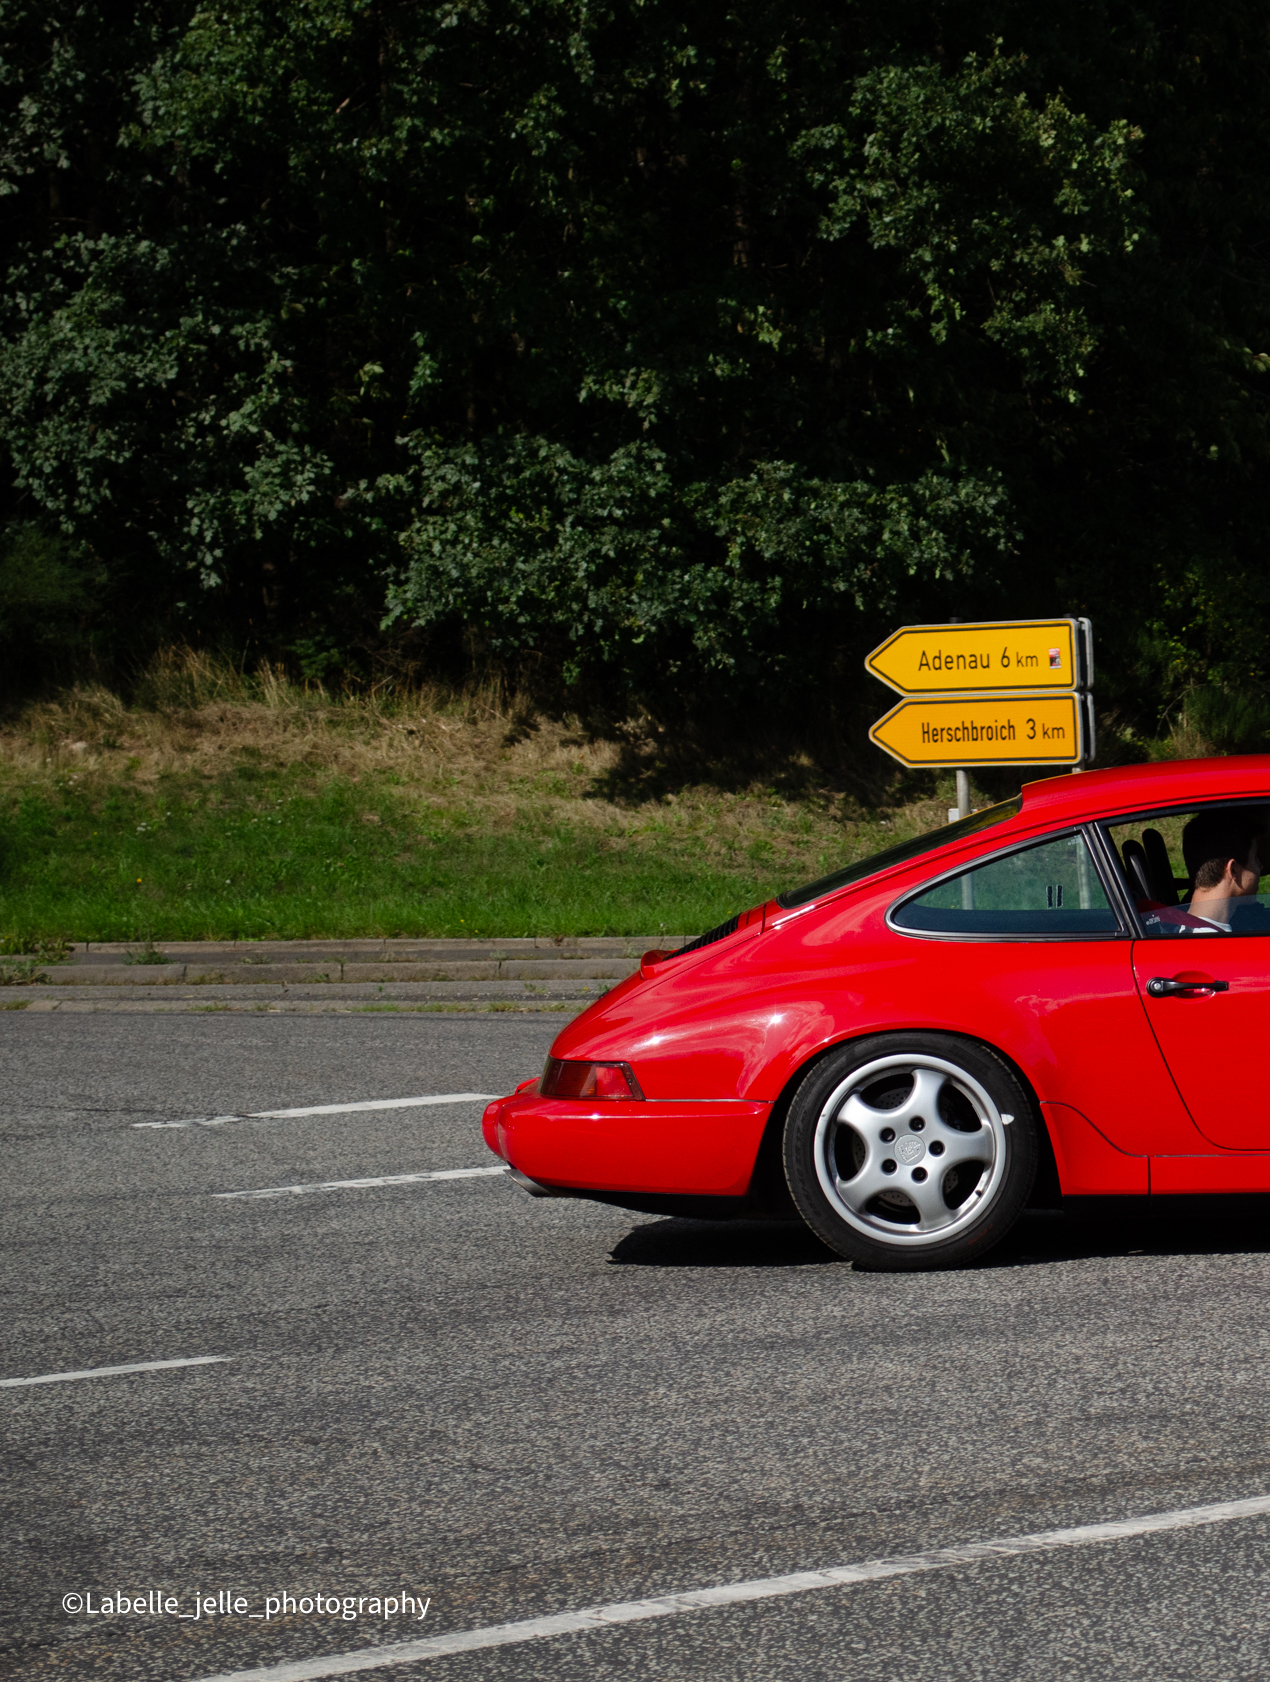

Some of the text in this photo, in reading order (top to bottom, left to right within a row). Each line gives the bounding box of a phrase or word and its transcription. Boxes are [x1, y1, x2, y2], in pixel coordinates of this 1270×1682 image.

[918, 649, 990, 671] Adenau
[1000, 647, 1011, 668] 6
[1016, 652, 1038, 667] km
[921, 718, 1065, 743] Herschbroich 3 km
